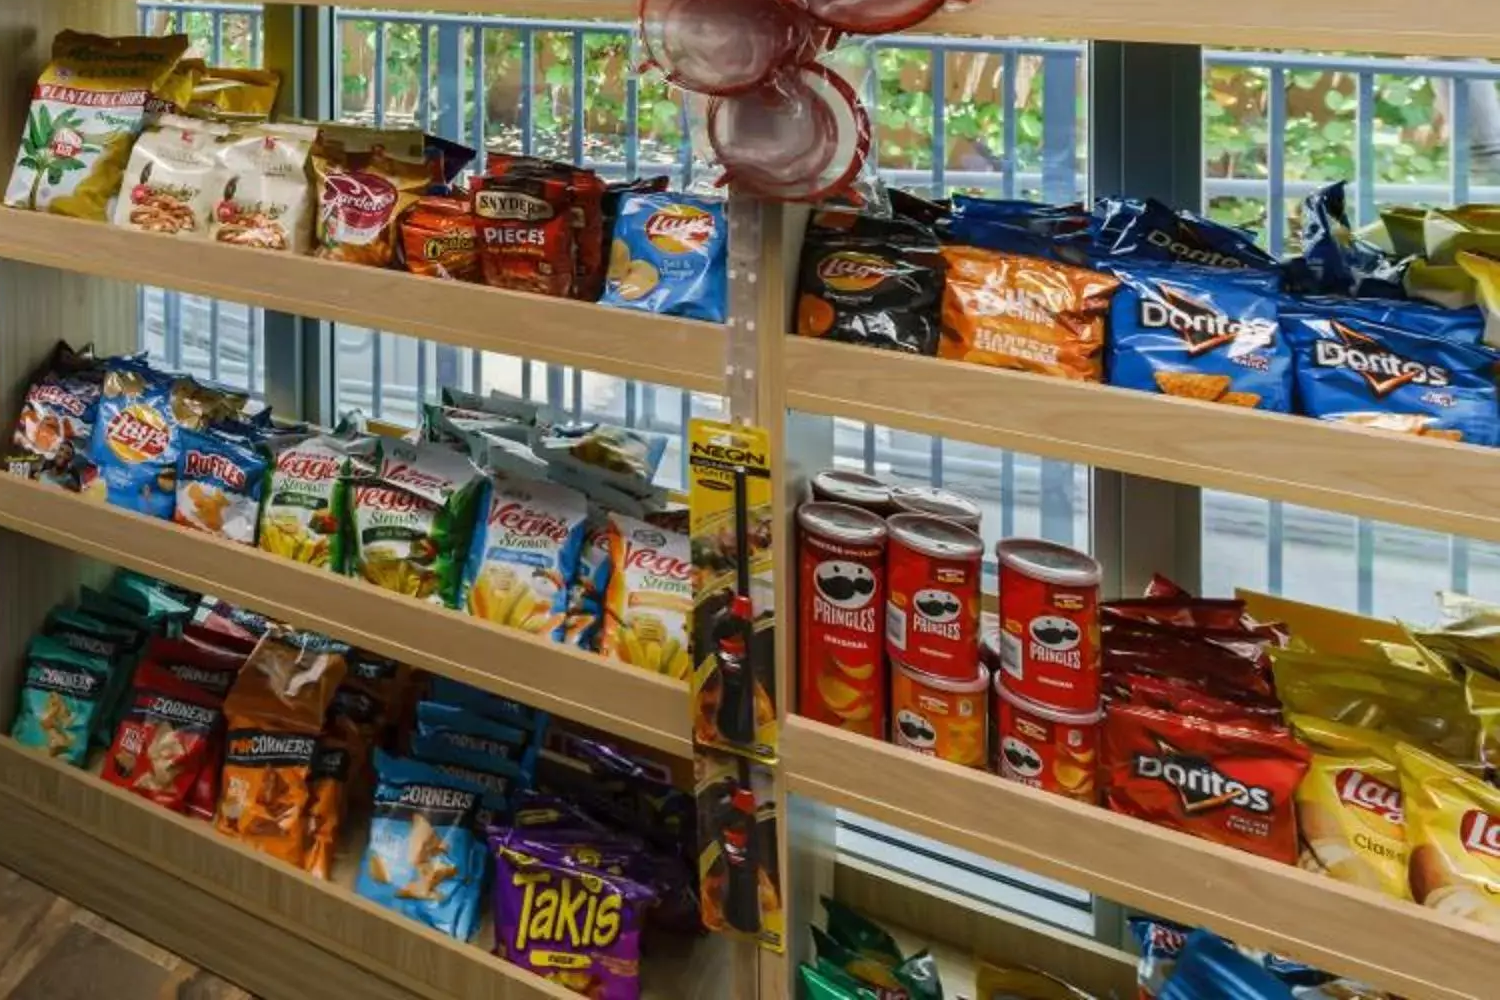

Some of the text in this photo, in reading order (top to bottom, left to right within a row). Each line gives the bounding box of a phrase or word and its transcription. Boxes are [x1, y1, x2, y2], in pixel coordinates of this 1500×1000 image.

[41, 85, 111, 106] PLANTAIN
[483, 227, 546, 245] PIECES
[1315, 340, 1449, 387] Doritos
[107, 412, 170, 456] Lay's
[692, 442, 765, 465] NEON
[184, 449, 247, 489] RUFFLES
[276, 450, 341, 481] Veggie
[813, 595, 876, 634] PRINGLES
[913, 613, 962, 642] PRINGLES
[1030, 641, 1081, 670] PRINGLES
[1137, 755, 1272, 813] Doritos
[1342, 769, 1406, 826] Lay
[512, 871, 623, 951] Takis
